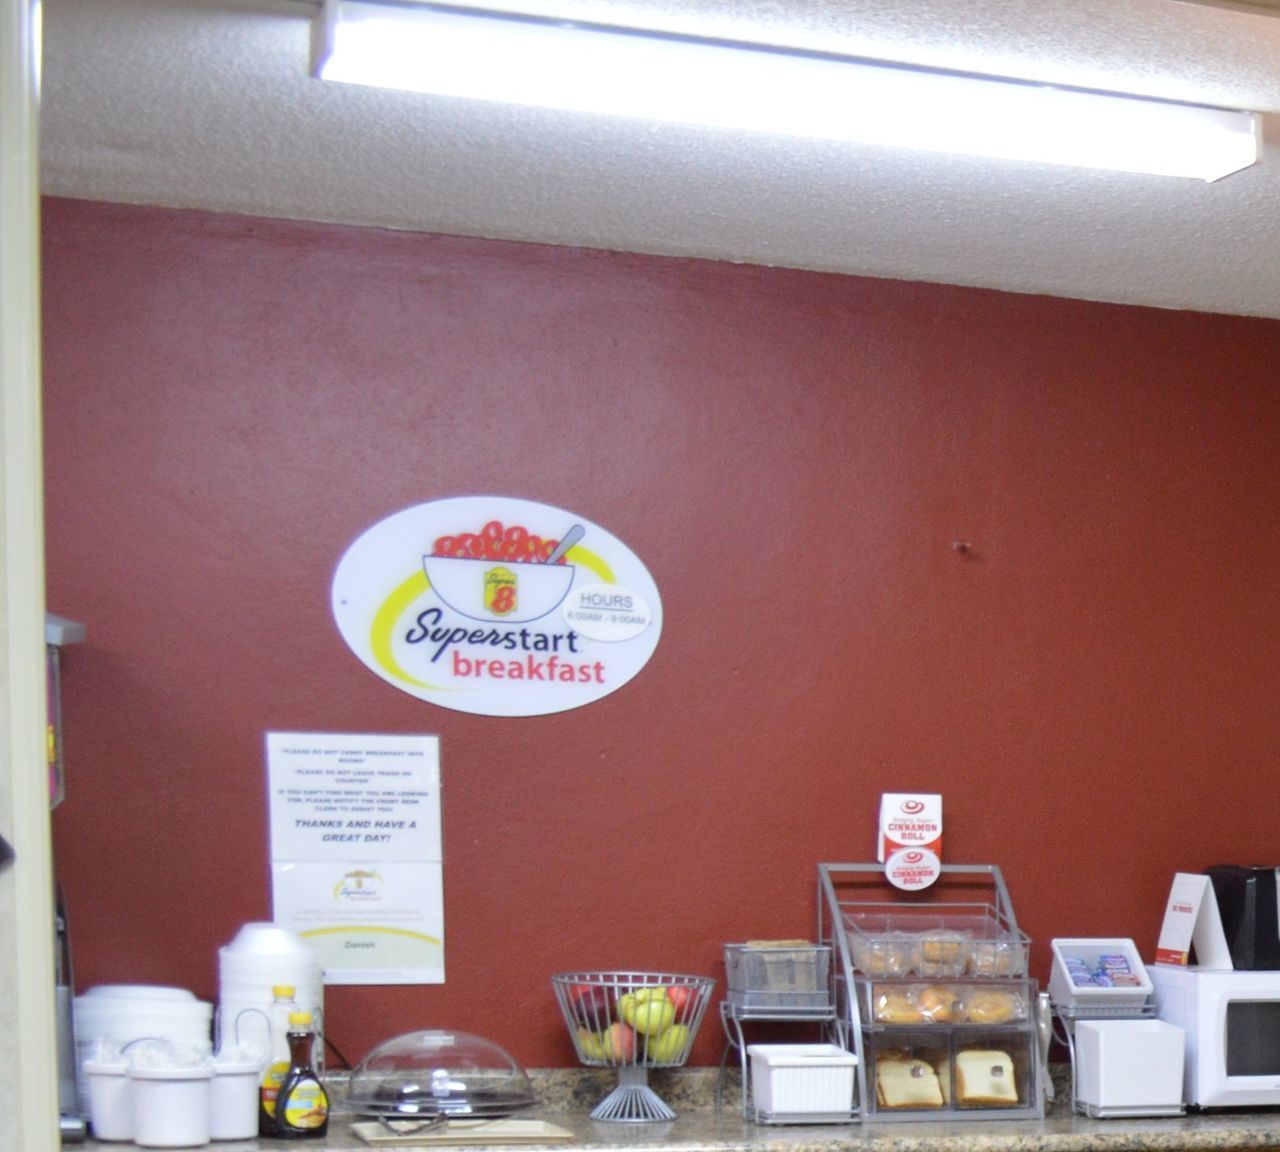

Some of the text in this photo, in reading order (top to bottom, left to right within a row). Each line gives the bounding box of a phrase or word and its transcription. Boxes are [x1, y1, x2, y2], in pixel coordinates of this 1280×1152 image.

[492, 586, 515, 613] 8
[580, 592, 633, 608] HOURS
[405, 607, 579, 663] Superstart
[452, 651, 605, 684] breakfast
[294, 819, 417, 830] THANKS AND HAVE A
[887, 823, 938, 832] CINNAMON
[322, 834, 361, 843] GREAT
[901, 832, 925, 841] ROLL
[892, 869, 935, 879] CINNAMON
